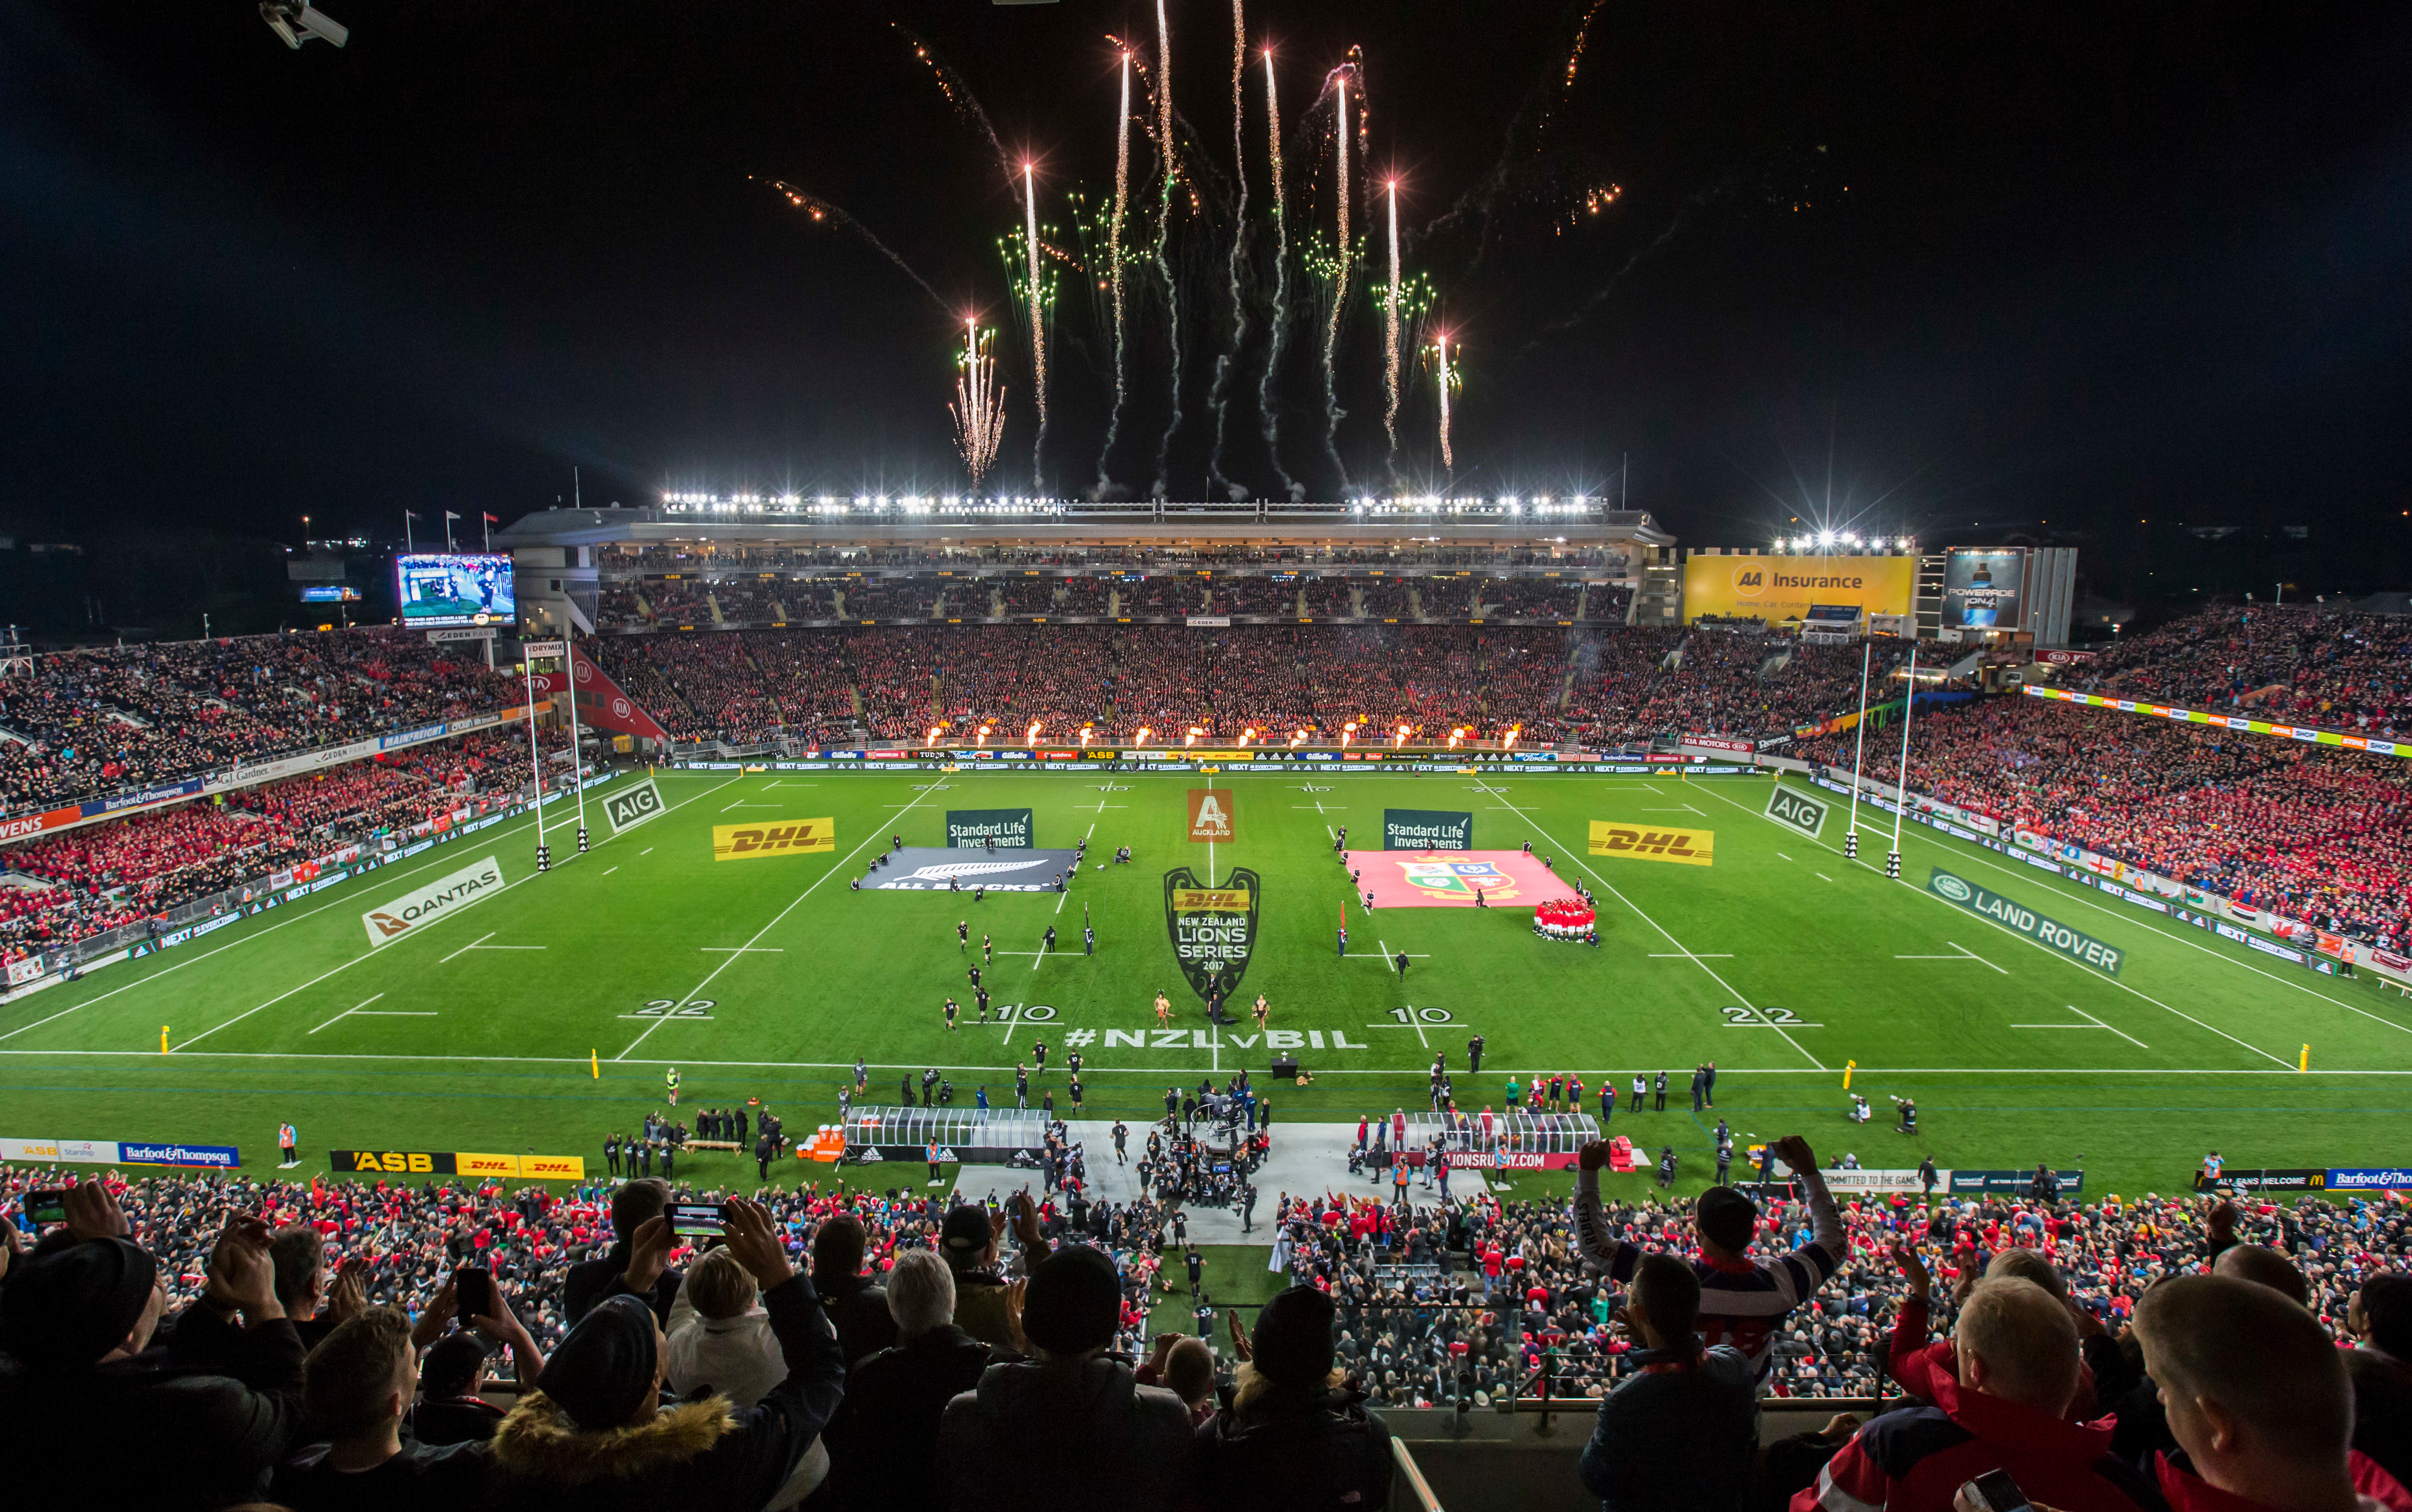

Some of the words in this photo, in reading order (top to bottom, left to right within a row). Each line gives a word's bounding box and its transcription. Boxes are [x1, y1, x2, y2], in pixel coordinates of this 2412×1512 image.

[1739, 572, 1762, 586] AA
[1774, 572, 1862, 588] Insurance
[1949, 588, 2015, 597] POWERADE
[533, 643, 562, 652] DRYMIX
[576, 666, 588, 676] KIA
[518, 704, 538, 716] STIL
[616, 704, 627, 713] KIA
[482, 714, 499, 724] trucks
[2208, 716, 2226, 725] STIHL
[384, 725, 443, 747] MAINFREIGHT
[2271, 726, 2291, 735] STIHL
[2295, 730, 2315, 738] SHOP
[1699, 739, 1730, 749] MOTORS
[1758, 734, 1791, 748] Resene
[2342, 738, 2366, 747] STIHL
[2370, 742, 2392, 750] SHOP
[329, 750, 347, 759] EDEN
[349, 745, 366, 753] PARK
[221, 774, 234, 784] G.J.
[105, 786, 183, 810] Barfoot&Thompson
[617, 791, 654, 822] AIG
[1774, 797, 1819, 826] AIG
[463, 821, 479, 835] NEXT
[951, 824, 1001, 837] Standard
[1004, 822, 1026, 835] Life
[1388, 823, 1439, 837] Standard
[1442, 825, 1463, 838] Life
[731, 825, 819, 852] DHL
[958, 836, 1025, 848] Invesments
[1605, 829, 1695, 857] DHL
[286, 884, 310, 901] NEXT
[317, 871, 347, 887] EVERYTHING
[403, 871, 497, 920] QANTAS
[1184, 893, 1239, 907] DHL
[2100, 880, 2124, 896] NEXT
[2130, 892, 2167, 910] EVERYTHING
[1202, 917, 1245, 926] ZEALAND
[161, 928, 192, 948] NEXT
[201, 912, 240, 932] EVERYTHING
[1179, 928, 1246, 942] LIONS
[1975, 892, 2036, 931] LAND
[2038, 920, 2118, 971] ROVER
[2216, 923, 2247, 943] NEXT
[2255, 938, 2302, 961] EVERYTHING
[1179, 945, 1247, 958] SERIES
[1203, 961, 1224, 970] 2017
[634, 999, 717, 1015] 22
[994, 1004, 1058, 1021] 10
[1386, 1007, 1454, 1023] 10
[1720, 1007, 1806, 1023] 22
[1065, 1028, 1367, 1049] #NZLvBIL
[23, 1146, 57, 1156] ASB
[64, 1148, 94, 1157] Starship
[126, 1146, 230, 1163] Barfoot&Thompson
[354, 1152, 433, 1172] ASB
[471, 1161, 508, 1170] DHL
[1446, 1154, 1544, 1167] LIONSRUY.COM
[1824, 1176, 1866, 1184] COMMITTED
[1869, 1176, 1878, 1184] TO
[1881, 1176, 1893, 1184] THE
[1895, 1176, 1918, 1185] GAME
[1578, 1203, 1597, 1244] REBELS
